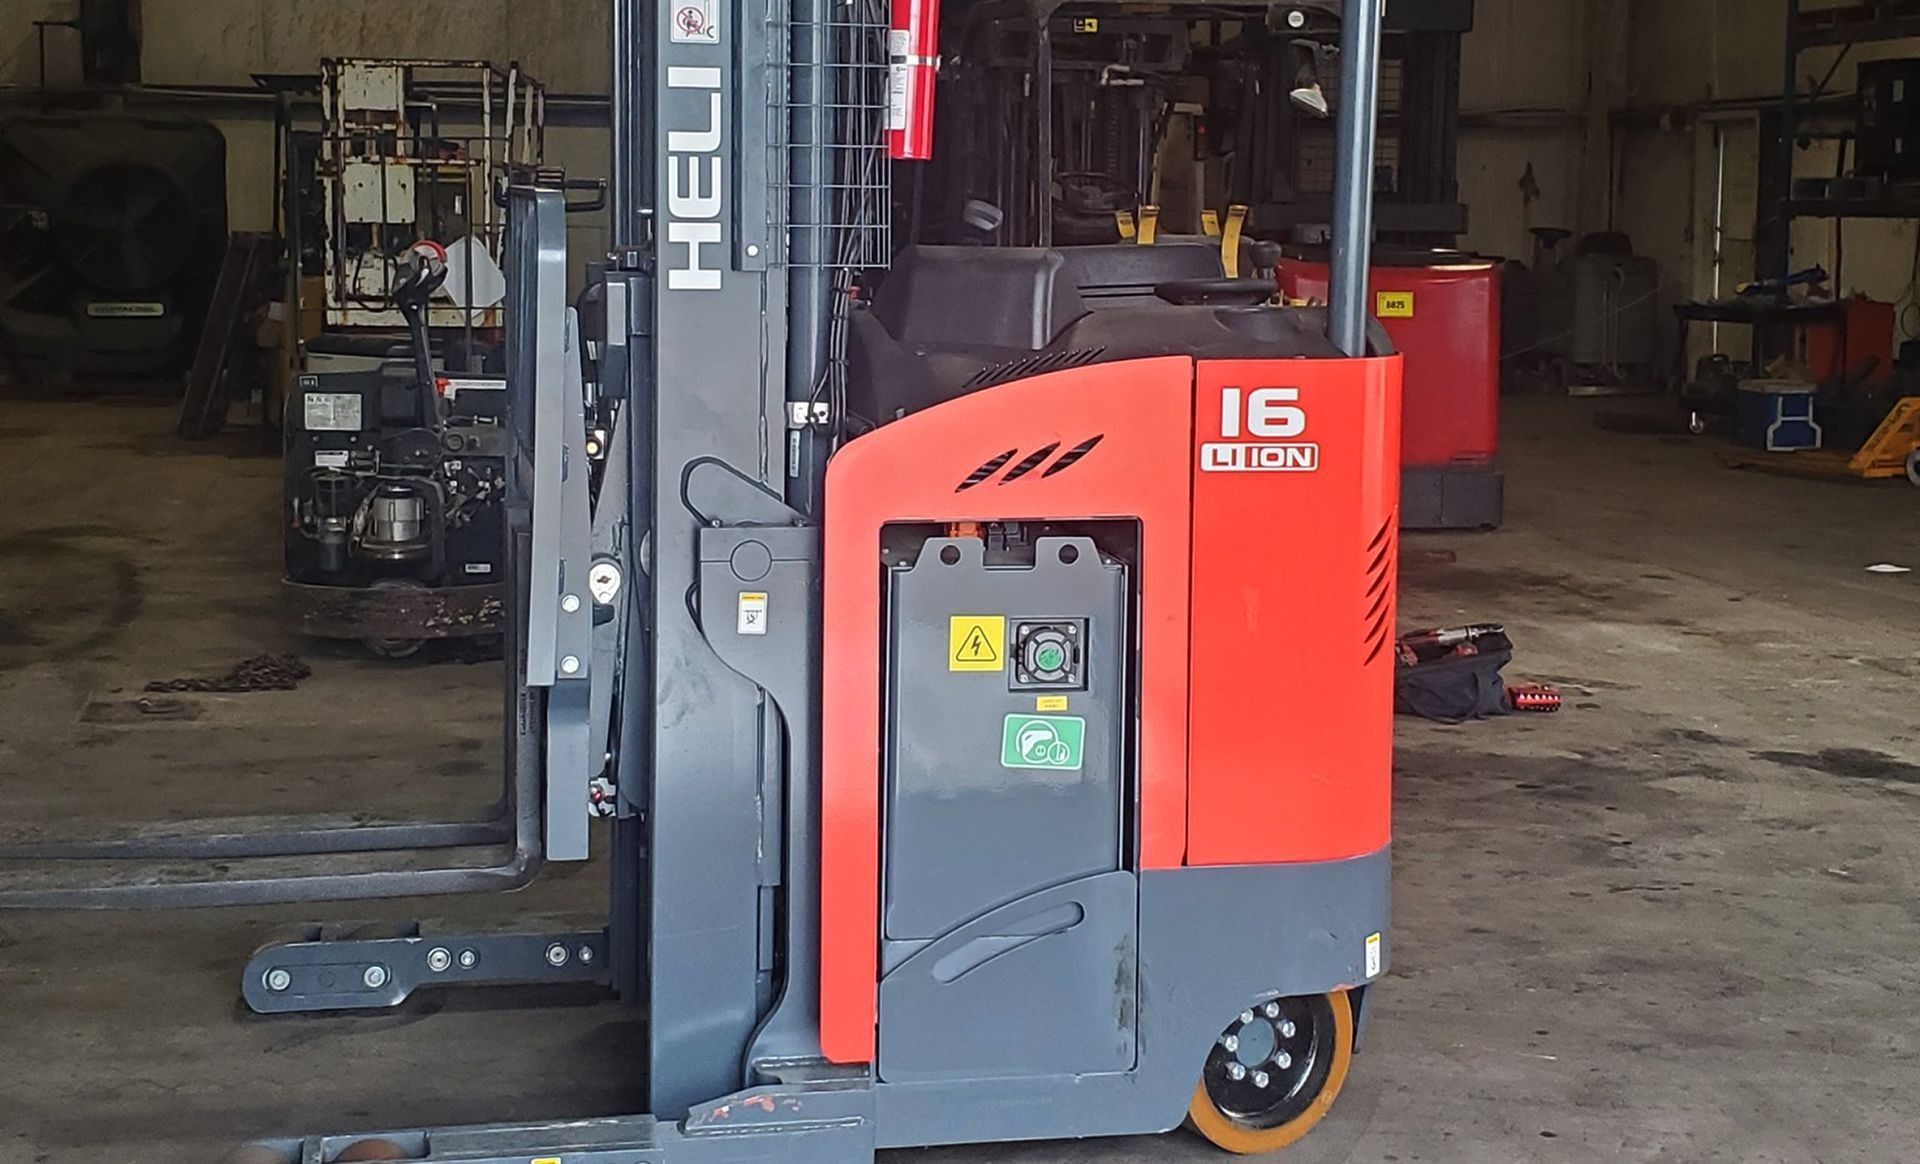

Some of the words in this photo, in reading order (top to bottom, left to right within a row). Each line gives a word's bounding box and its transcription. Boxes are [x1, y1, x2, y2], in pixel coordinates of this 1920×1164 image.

[668, 67, 721, 290] HELI
[1221, 387, 1306, 438] 16
[1212, 448, 1237, 467] LI
[1250, 447, 1312, 468] ION
